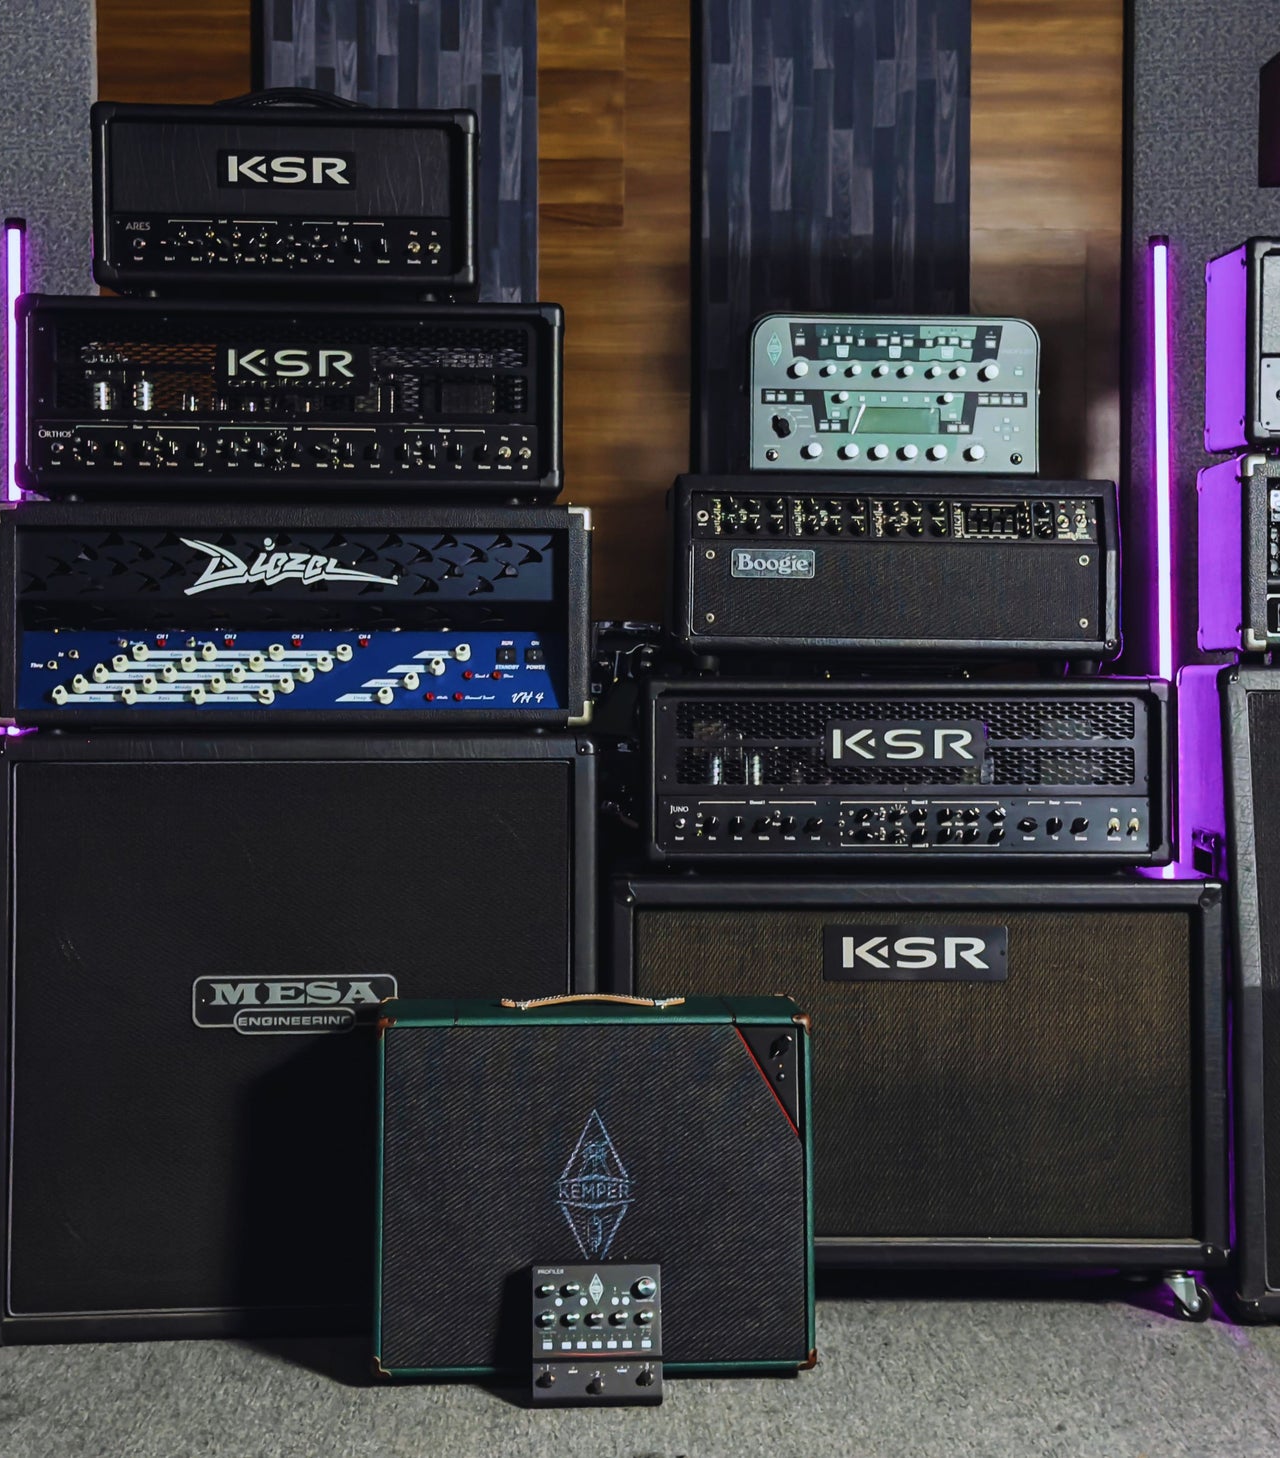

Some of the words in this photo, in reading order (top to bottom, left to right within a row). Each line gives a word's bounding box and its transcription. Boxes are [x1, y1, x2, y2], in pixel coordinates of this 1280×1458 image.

[227, 155, 350, 185] KSR
[125, 222, 151, 231] ARES
[227, 348, 355, 378] KSR
[179, 537, 399, 597] Diezel
[737, 553, 809, 575] Boogie
[511, 692, 533, 704] VH
[535, 692, 545, 703] 4
[832, 728, 974, 760] KSR
[670, 805, 689, 814] JUNO
[842, 936, 990, 969] KSR
[209, 981, 381, 1006] MESA
[559, 1183, 630, 1200] KEMPER
